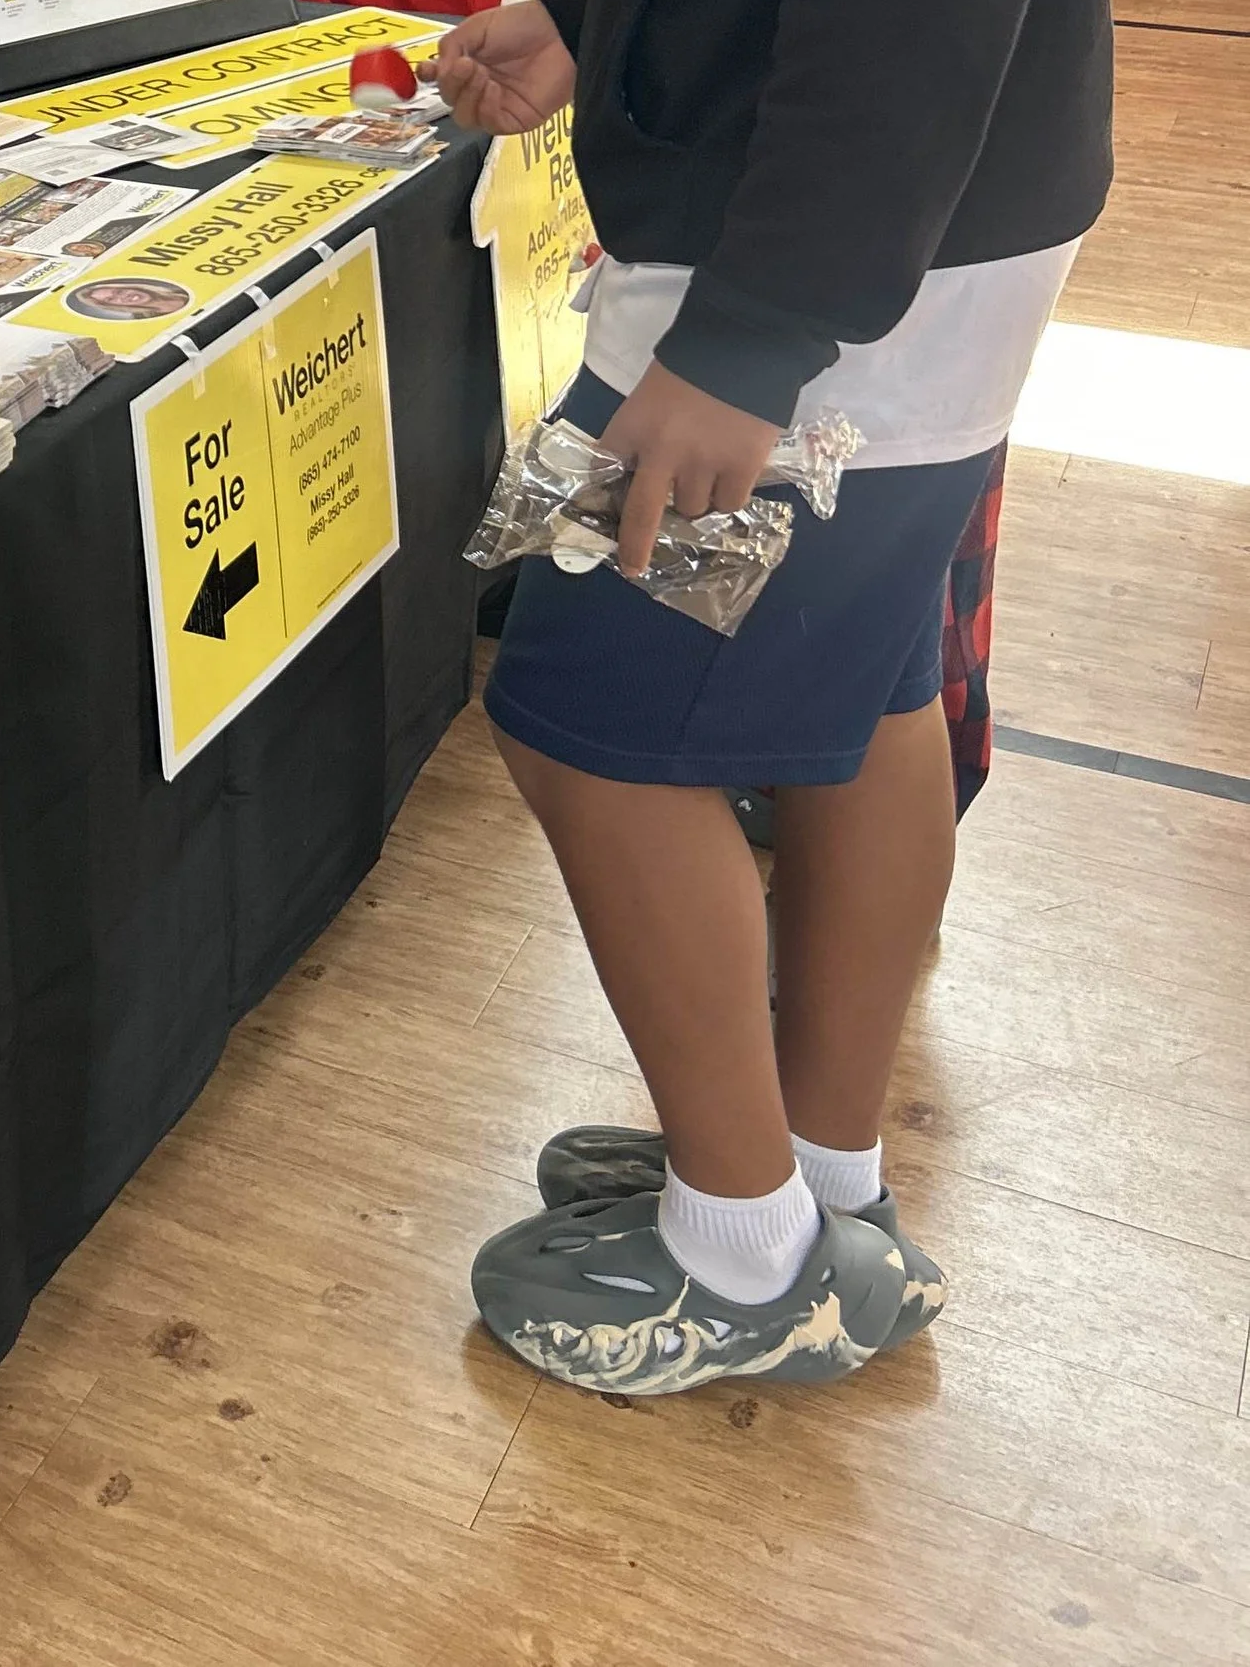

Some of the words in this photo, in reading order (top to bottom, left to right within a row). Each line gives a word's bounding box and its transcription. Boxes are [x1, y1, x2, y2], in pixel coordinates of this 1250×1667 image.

[182, 17, 407, 81] CONTRACT
[189, 83, 351, 135] OMING
[128, 214, 243, 268] Missy
[213, 181, 294, 214] Hall
[194, 179, 365, 276] 865-250-3326
[272, 313, 366, 415] Weichert
[184, 418, 232, 487] For
[290, 401, 340, 456] Advantage
[341, 382, 362, 410] Plus
[299, 461, 321, 495] (865)
[322, 425, 361, 471] 474-7100
[310, 482, 336, 516] Missy
[337, 462, 354, 491] Hall
[183, 475, 245, 549] Sale
